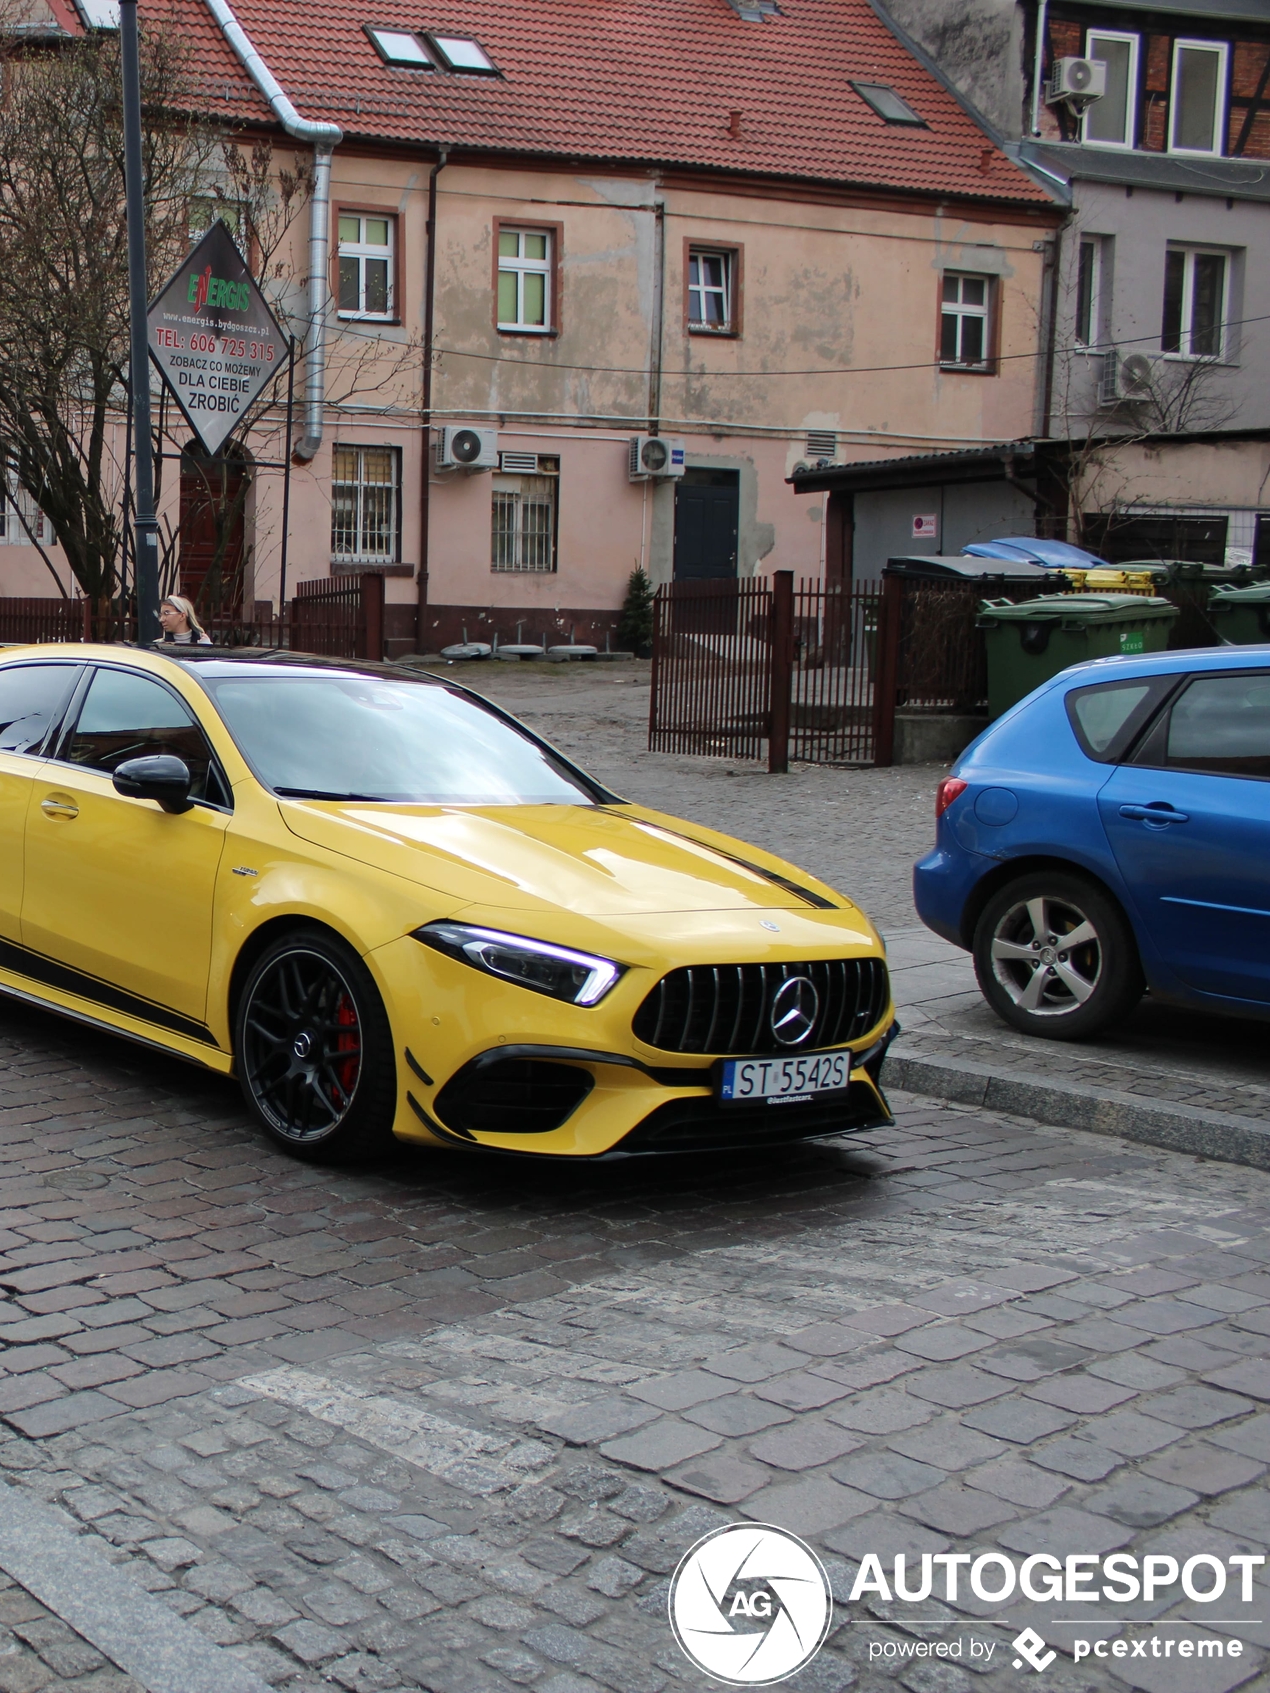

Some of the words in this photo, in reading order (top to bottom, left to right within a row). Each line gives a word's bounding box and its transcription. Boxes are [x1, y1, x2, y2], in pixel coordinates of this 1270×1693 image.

[186, 267, 251, 313] ENERGIS
[162, 312, 270, 336] www.energis.bydgoszcz.pl
[156, 328, 185, 348] TEL:
[190, 333, 217, 354] 606
[220, 337, 246, 358] 725
[249, 342, 275, 362] 315
[169, 355, 208, 371] ZOBACZ
[210, 360, 223, 372] CO
[224, 361, 262, 377] MOŻEMY
[179, 371, 205, 388] DLA
[208, 375, 250, 393] CIEBIE
[188, 392, 241, 414] ZROBIĆ
[1121, 641, 1143, 652] SZKŁO
[739, 1062, 773, 1096] ST
[780, 1055, 845, 1093] 5542S
[723, 1085, 733, 1095] PL
